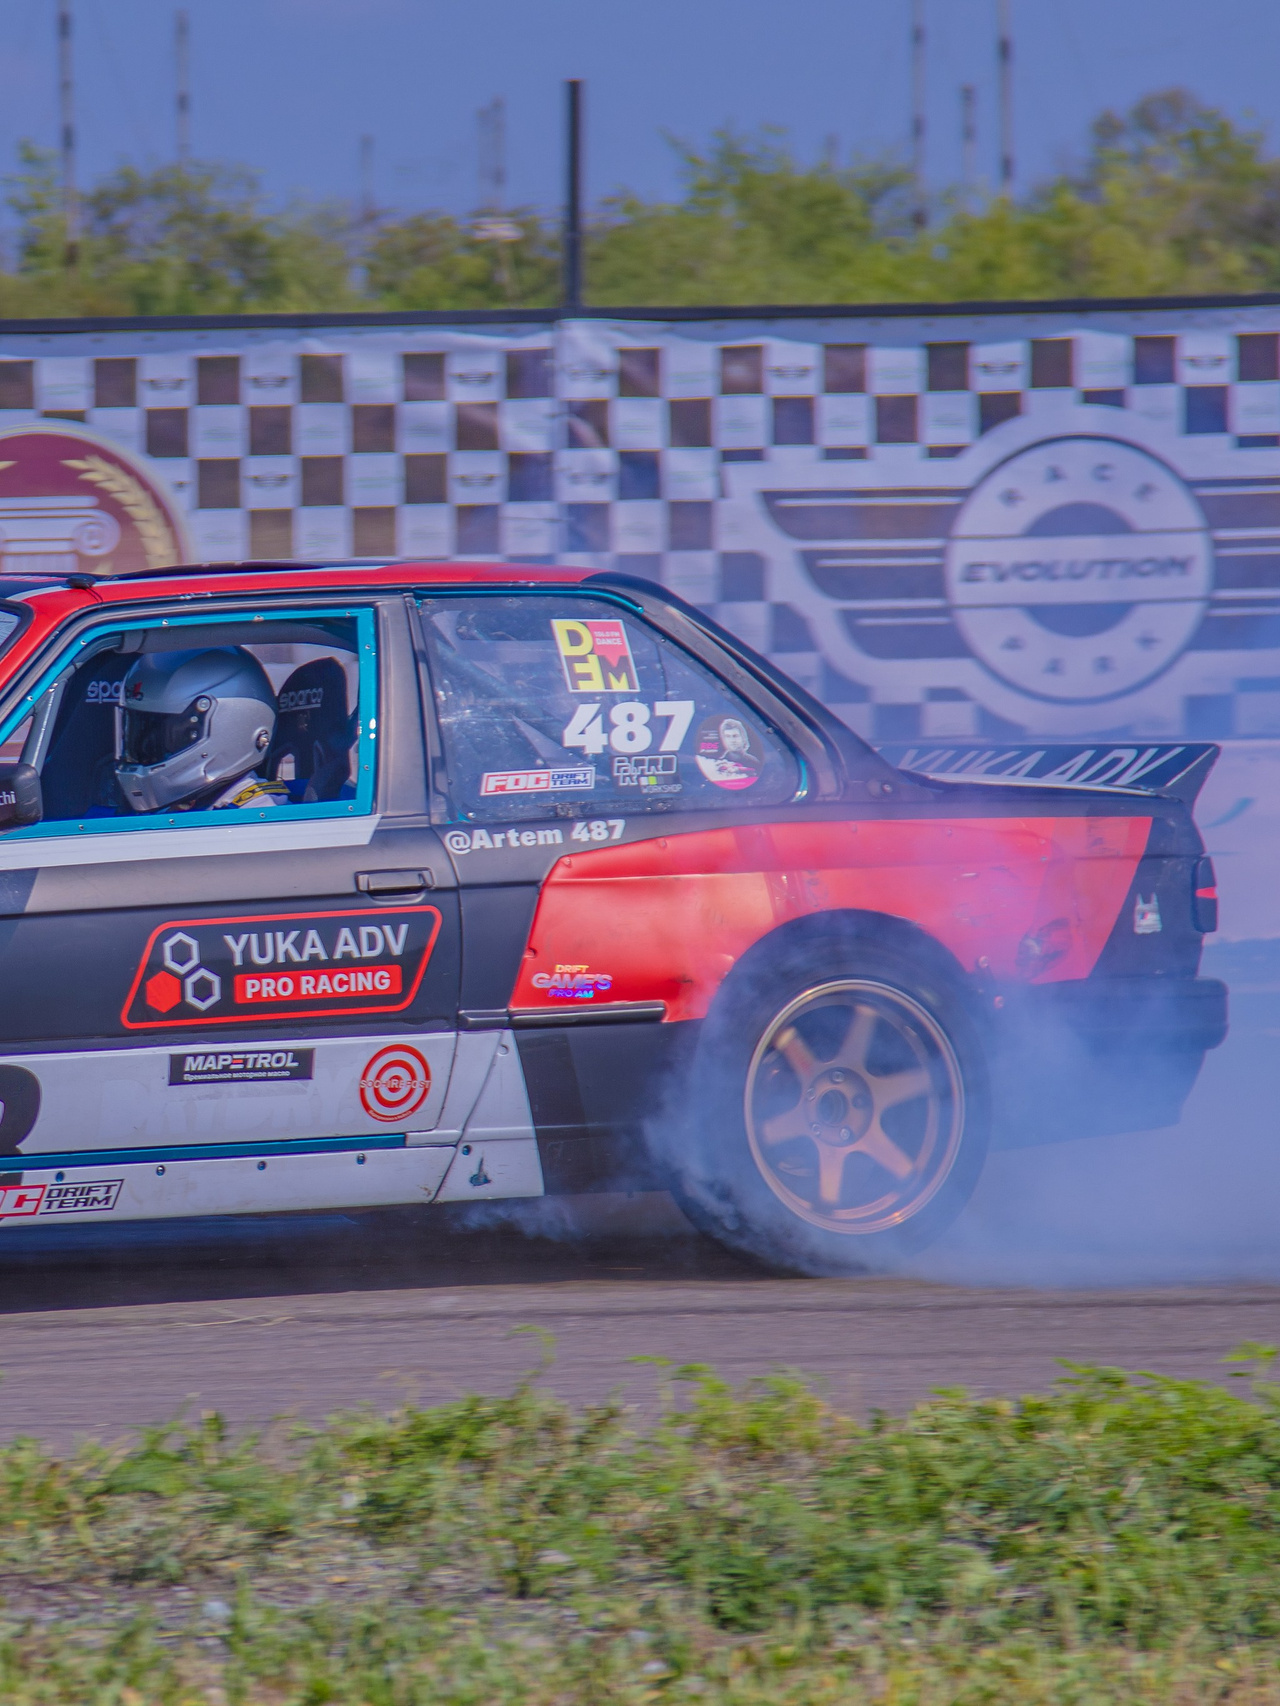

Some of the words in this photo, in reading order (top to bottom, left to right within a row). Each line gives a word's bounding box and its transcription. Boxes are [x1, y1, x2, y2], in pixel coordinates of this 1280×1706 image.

[960, 556, 1195, 583] EVOLUTION
[563, 700, 695, 754] 487
[551, 772, 588, 780] DRIFT
[445, 828, 563, 855] @Artem
[572, 819, 626, 842] 487
[223, 929, 329, 966] YUKA
[332, 923, 410, 960] ADV
[554, 964, 590, 974] DRIFT
[245, 974, 295, 999] PRO
[300, 970, 391, 995] RACING
[184, 1052, 299, 1071] MAPETROL
[44, 1194, 112, 1210] TEAM
[46, 1183, 118, 1199] DRIFT
